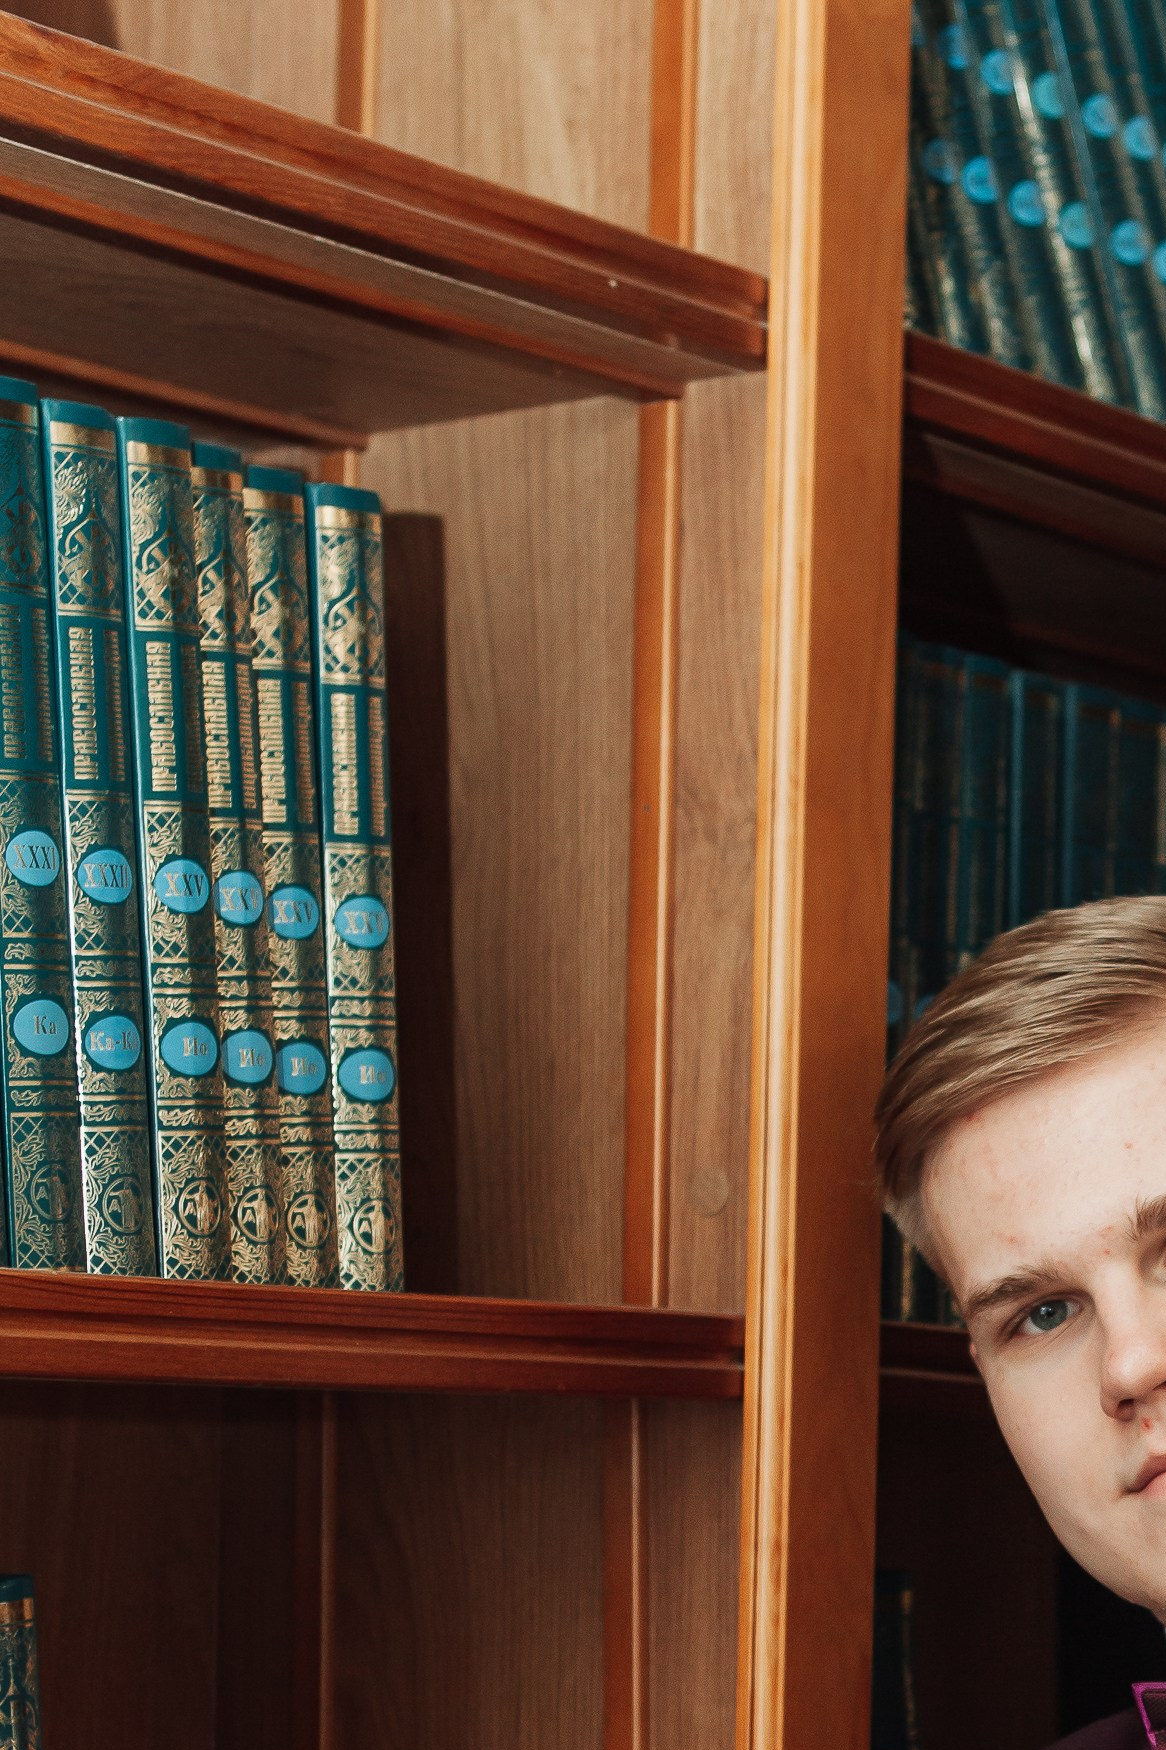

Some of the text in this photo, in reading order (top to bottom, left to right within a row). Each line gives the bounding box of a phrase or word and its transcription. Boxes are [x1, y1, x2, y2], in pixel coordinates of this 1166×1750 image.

[0, 603, 27, 760] ПРАВОСЛАВНАЯ
[68, 626, 99, 781] ПРАВОСЛАВНАЯ
[146, 641, 178, 792] ПРАВОСЛАВНАЯ
[201, 661, 232, 809] ПРАВОСЛАВНАЯ
[257, 678, 287, 824] ПРАВОСЛАВНАЯ
[330, 693, 359, 836] ПРАВОСЛАВНАЯ
[33, 1015, 57, 1035] Ка
[182, 1036, 209, 1057] Ио
[239, 1047, 265, 1068] Ио
[290, 1056, 317, 1077] Ио
[358, 1064, 387, 1084] Ио
